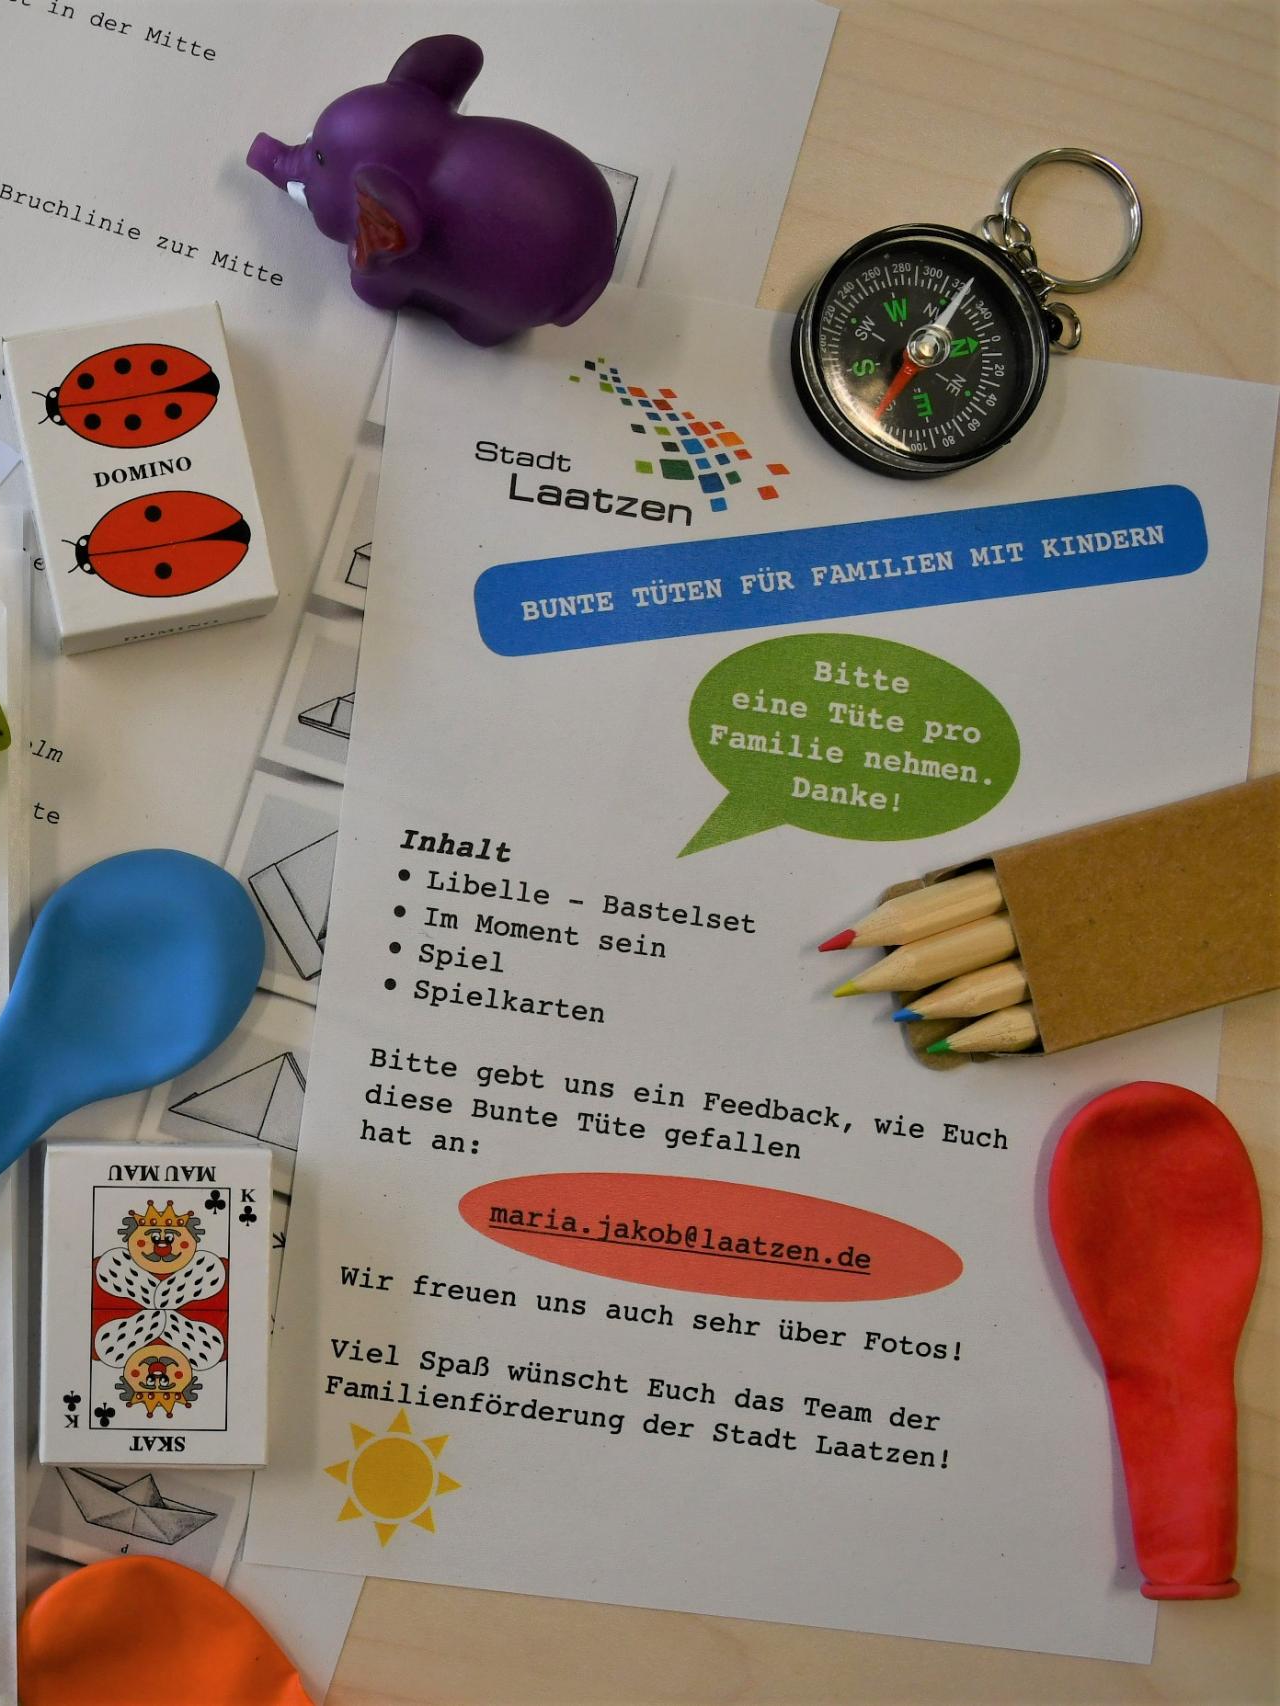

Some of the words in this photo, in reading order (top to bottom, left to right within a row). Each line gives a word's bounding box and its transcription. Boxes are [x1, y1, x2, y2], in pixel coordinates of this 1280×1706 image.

[48, 0, 75, 19] in
[90, 12, 132, 34] der
[144, 26, 216, 61] Mitte
[156, 236, 199, 258] zur
[211, 250, 283, 286] Mitte
[862, 266, 882, 283] 260
[892, 262, 912, 273] 280
[923, 266, 943, 279] 300
[837, 281, 856, 299] 240
[823, 305, 836, 325] 220
[883, 298, 910, 322] W
[975, 300, 993, 320] 340
[855, 315, 875, 341] SW
[852, 359, 875, 376] S
[994, 363, 1005, 378] 20
[946, 373, 967, 397] NE
[985, 392, 996, 407] 40
[912, 392, 933, 417] E
[967, 418, 981, 432] 60
[910, 442, 928, 451] 100
[942, 435, 956, 448] 80
[475, 441, 571, 472] Stadt
[94, 456, 193, 488] DOMINO
[509, 473, 692, 526] Laatzen
[521, 592, 613, 621] BUNTE
[632, 579, 722, 607] TÜTEN
[740, 567, 795, 594] FÜR
[811, 551, 953, 586] FAMILIEN
[970, 543, 1023, 566] MIT
[1041, 525, 1164, 558] KINDERN
[814, 661, 909, 693] Bitte
[733, 689, 807, 718] eine
[829, 702, 904, 732] Tüte
[923, 721, 981, 743] pro
[710, 724, 843, 763] Familie
[864, 751, 991, 785] nehmen.
[792, 776, 899, 811] Danke!
[400, 830, 511, 862] Inhalt
[427, 871, 549, 905] Libelle
[602, 895, 756, 933] Bastelset
[424, 907, 458, 929] Im
[475, 914, 579, 946] Moment
[599, 934, 666, 958] sein
[419, 944, 503, 973] Spiel
[414, 980, 604, 1023] Spielkarten
[369, 1048, 457, 1077] Bitte
[477, 1065, 544, 1089] gebt
[565, 1077, 614, 1098] uns
[634, 1083, 684, 1107] ein
[703, 1092, 852, 1134] Feedback,
[874, 1115, 924, 1138] wie
[942, 1123, 1008, 1150] Euch
[365, 1084, 452, 1113] diese
[471, 1099, 558, 1127] Bunte
[578, 1112, 645, 1138] Tüte
[665, 1128, 800, 1159] gefallen
[360, 1119, 411, 1145] hat
[432, 1135, 479, 1154] an:
[108, 1164, 159, 1181] MAU
[164, 1165, 217, 1182] MAU
[240, 1189, 256, 1203] K
[489, 1203, 871, 1273] maria.jakob@laatzen.de
[341, 1266, 394, 1291] Wir
[413, 1275, 516, 1306] freuen
[537, 1295, 586, 1315] uns
[606, 1304, 673, 1326] auch
[693, 1313, 760, 1336] sehr
[779, 1319, 846, 1347] über
[864, 1332, 960, 1361] Fotos!
[331, 1339, 399, 1366] Viel
[420, 1351, 489, 1377] Spaß
[507, 1362, 628, 1393] wünscht
[647, 1378, 715, 1404] Euch
[735, 1388, 784, 1412] das
[804, 1397, 872, 1423] Team
[890, 1407, 940, 1431] der
[64, 1414, 80, 1429] K
[325, 1375, 625, 1434] Familienförderung
[643, 1414, 694, 1438] der
[713, 1423, 797, 1450] Stadt
[815, 1435, 948, 1469] Laatzen!
[129, 1435, 186, 1452] SKAT
